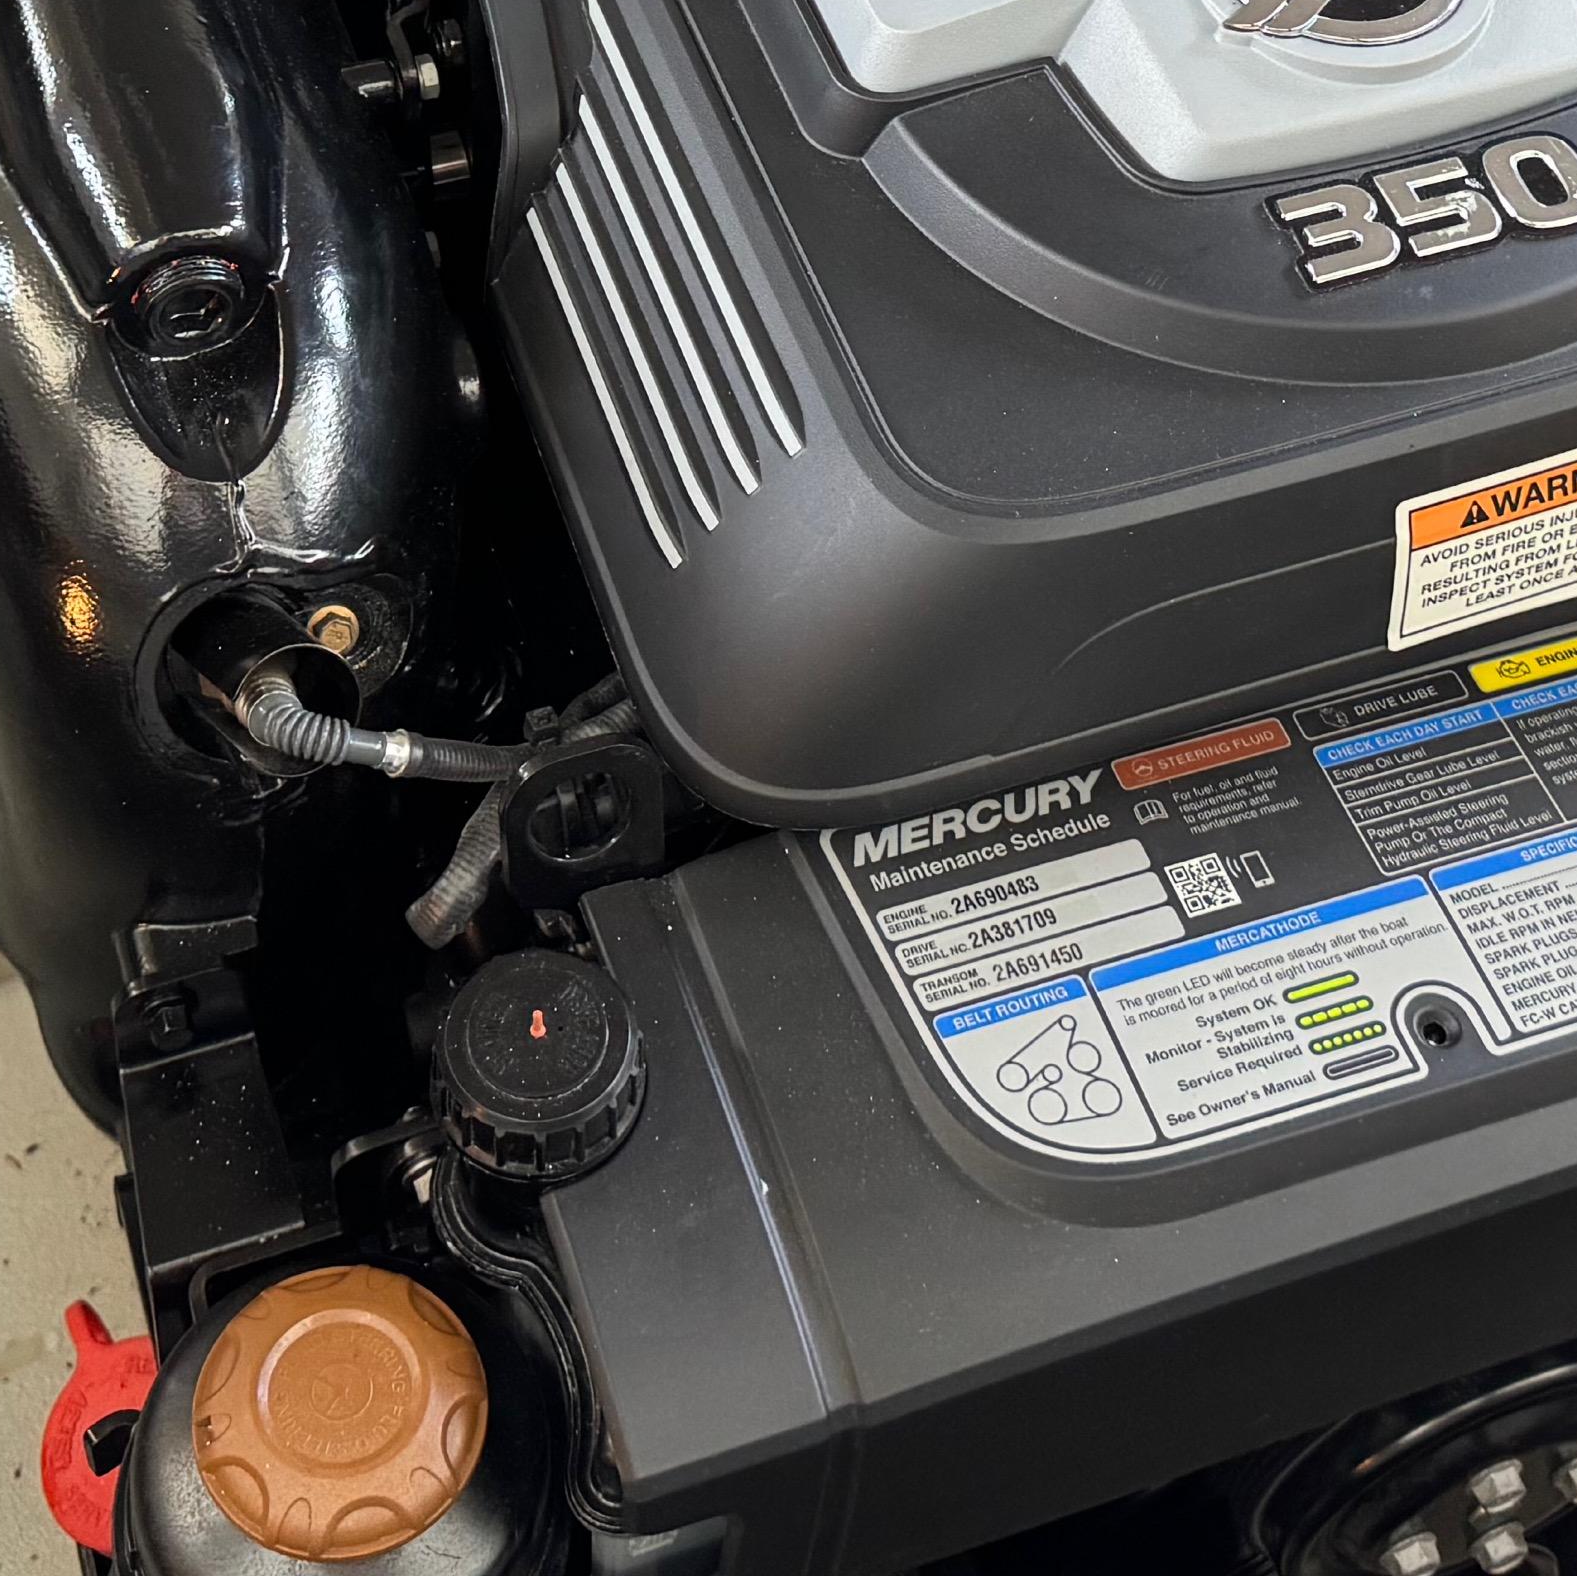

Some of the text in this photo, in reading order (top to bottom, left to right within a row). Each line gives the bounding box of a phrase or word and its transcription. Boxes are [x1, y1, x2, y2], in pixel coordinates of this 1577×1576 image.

[1420, 541, 1469, 567] AVOID
[1474, 523, 1545, 550] SERIOUS
[1449, 548, 1496, 573] FROM
[1501, 536, 1536, 559] FIRE
[1541, 529, 1564, 544] OR
[1420, 559, 1509, 595] RESULTING
[1515, 541, 1560, 564] FROM
[1421, 580, 1489, 608] INSPECT
[1494, 557, 1558, 586] SYSTEM
[1466, 584, 1515, 608] LEAST
[1520, 570, 1564, 591] ONCE
[1568, 565, 1577, 576] A
[1354, 685, 1438, 716] DRIVE LUBE
[1511, 690, 1557, 710] CHECK
[1158, 730, 1274, 770] STEERING FLUID
[1328, 709, 1482, 760] CHECK EACH DAY START
[1332, 746, 1427, 781] Engine Oil Level
[1405, 769, 1435, 784] Gear
[1436, 761, 1467, 776] Lube
[1466, 750, 1500, 767] Level
[855, 769, 1102, 866] MERCURY
[1354, 779, 1472, 819] Trim Pump Oil Level
[1366, 794, 1509, 840] Power-Assisted Steering
[1374, 808, 1508, 854] Pump Or The Compact
[1381, 810, 1553, 868] Hydraulic Steering Fluid Level
[869, 814, 1111, 892] Maintenance Schedule
[887, 876, 1039, 934] SERIAL NO. 2A690483
[1449, 883, 1498, 904] MODEL
[1457, 880, 1560, 920] DISPLACEMENT
[883, 904, 927, 924] ENGINE
[1215, 911, 1322, 952] MERCATHODE
[1466, 916, 1502, 934] MAX.
[1501, 903, 1544, 923] W.O.T.
[1544, 894, 1576, 911] RPM
[1475, 931, 1508, 950] IDLE
[1508, 922, 1540, 940] RPM
[1540, 917, 1556, 930] IN
[902, 940, 938, 958] DRIVE
[906, 908, 1057, 968] SERIAL NO. 2A381709
[1484, 942, 1532, 964] SPARK
[920, 968, 978, 992] TRANSOM
[925, 943, 1083, 1003] SERIAL NO. 2A691450
[1493, 957, 1541, 980] SPARK
[1502, 971, 1556, 996] ENGINE
[952, 986, 1068, 1030] BELT ROUTING
[1195, 994, 1277, 1028] System OK
[1511, 982, 1576, 1012] MERCURY
[1520, 1006, 1556, 1027] FC-W
[1145, 1040, 1202, 1064] Monitor
[1214, 1020, 1270, 1043] System
[1216, 1030, 1294, 1059] Stabilizing
[1177, 1044, 1303, 1092] Service Required
[1166, 1070, 1316, 1126] See Owner's Manual
